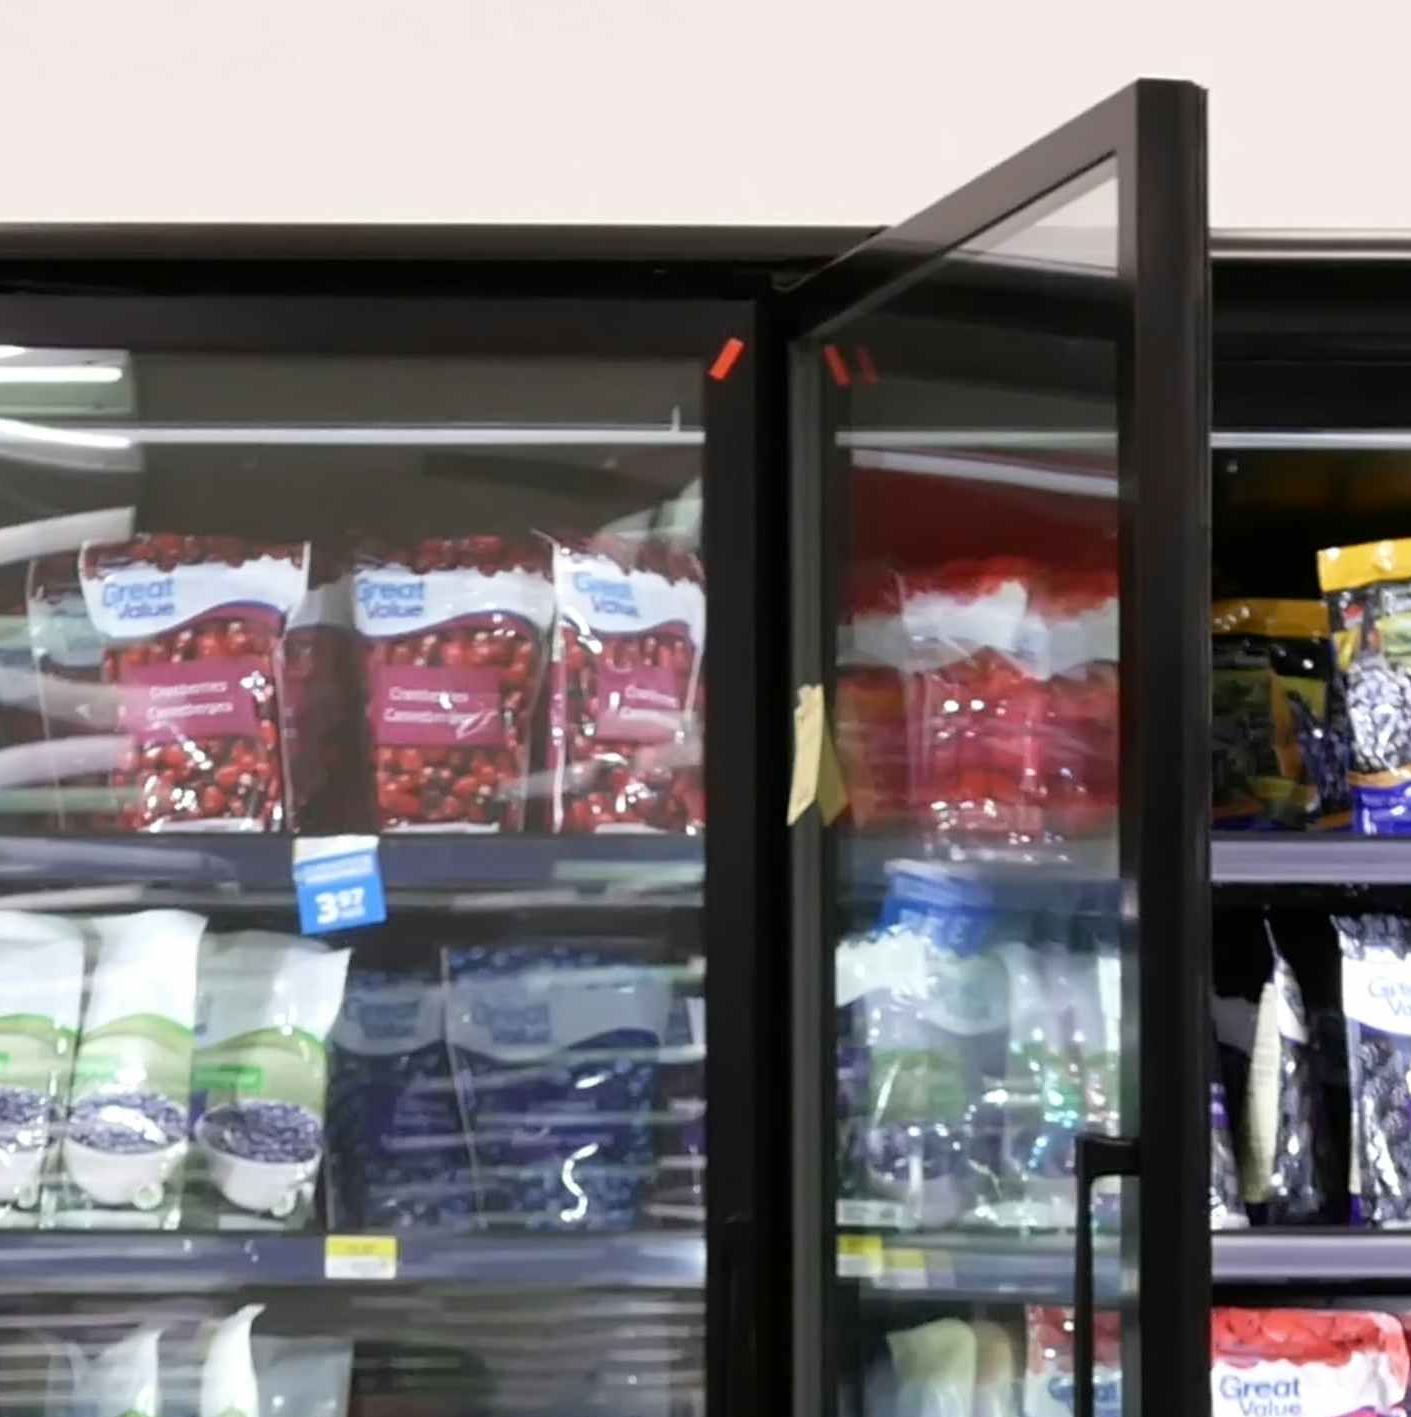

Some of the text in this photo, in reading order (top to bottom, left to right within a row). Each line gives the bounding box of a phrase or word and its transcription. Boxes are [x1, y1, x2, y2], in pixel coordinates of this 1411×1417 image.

[102, 577, 175, 606] Great
[357, 575, 426, 601] Great
[364, 597, 424, 619] Value
[1219, 1373, 1301, 1400] Great
[1239, 1396, 1302, 1417] Value
